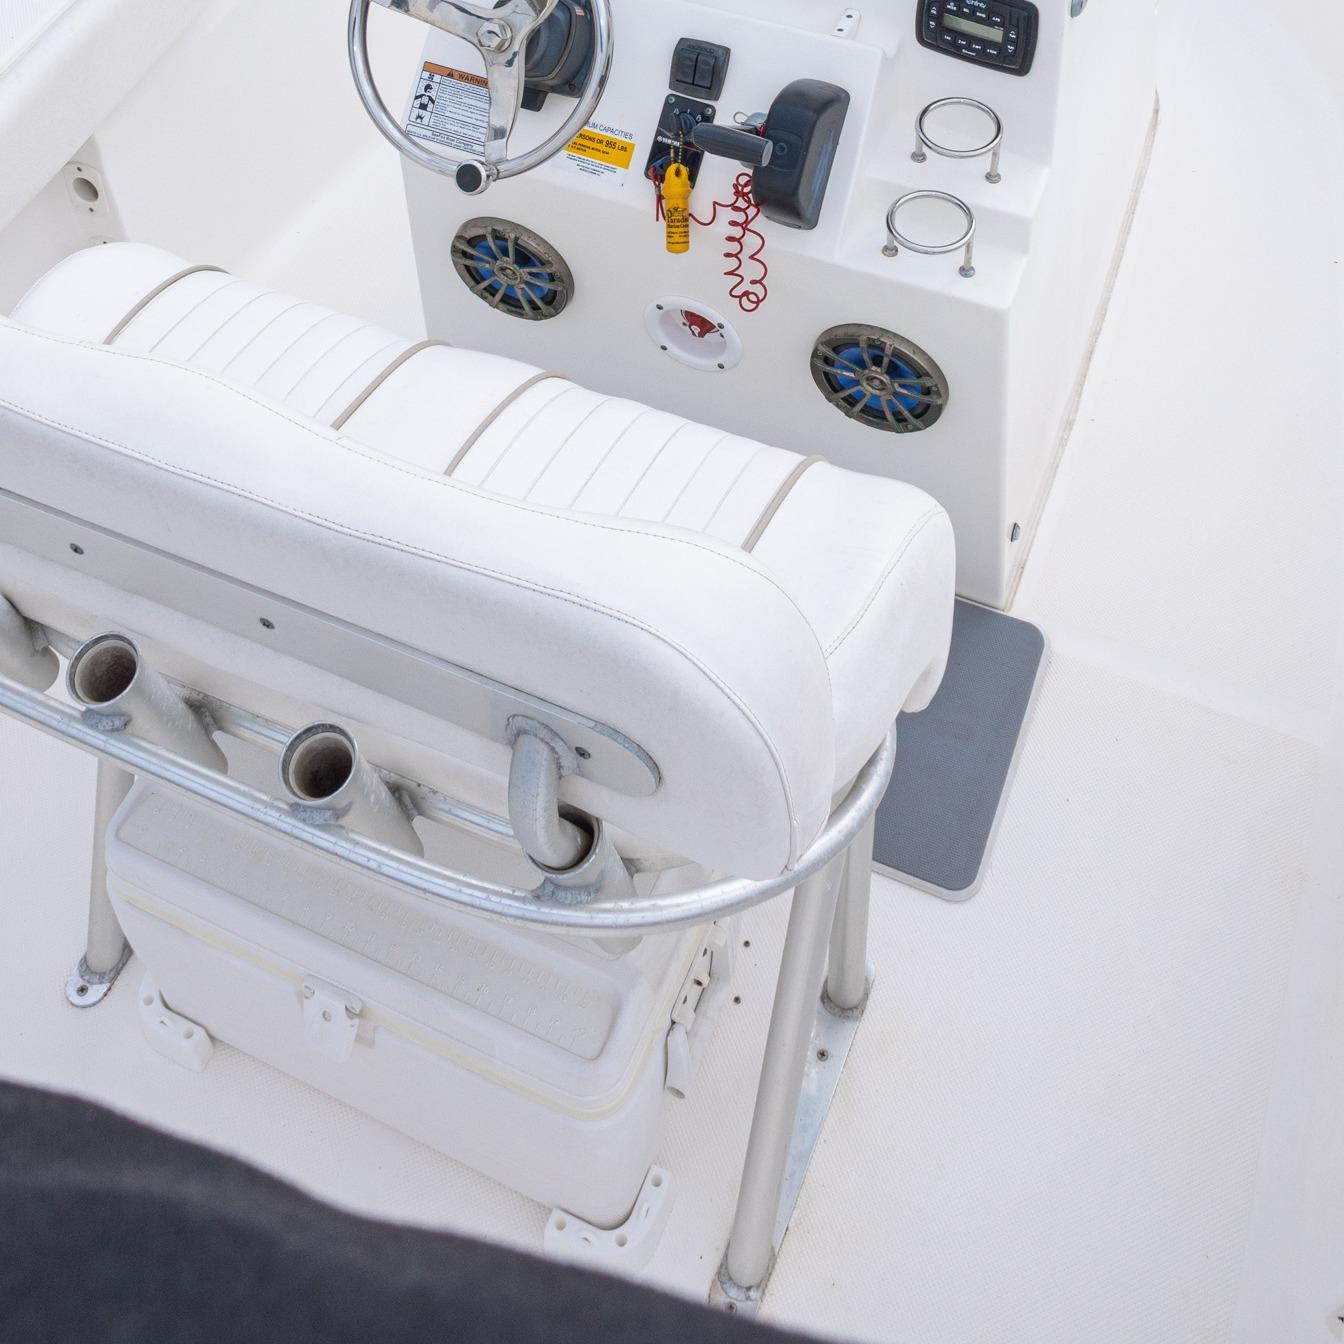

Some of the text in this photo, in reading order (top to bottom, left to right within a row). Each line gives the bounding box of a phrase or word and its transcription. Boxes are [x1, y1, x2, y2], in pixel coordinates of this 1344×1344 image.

[458, 72, 489, 87] WARNIN
[599, 124, 634, 141] CAPACITIES
[604, 139, 617, 150] 955
